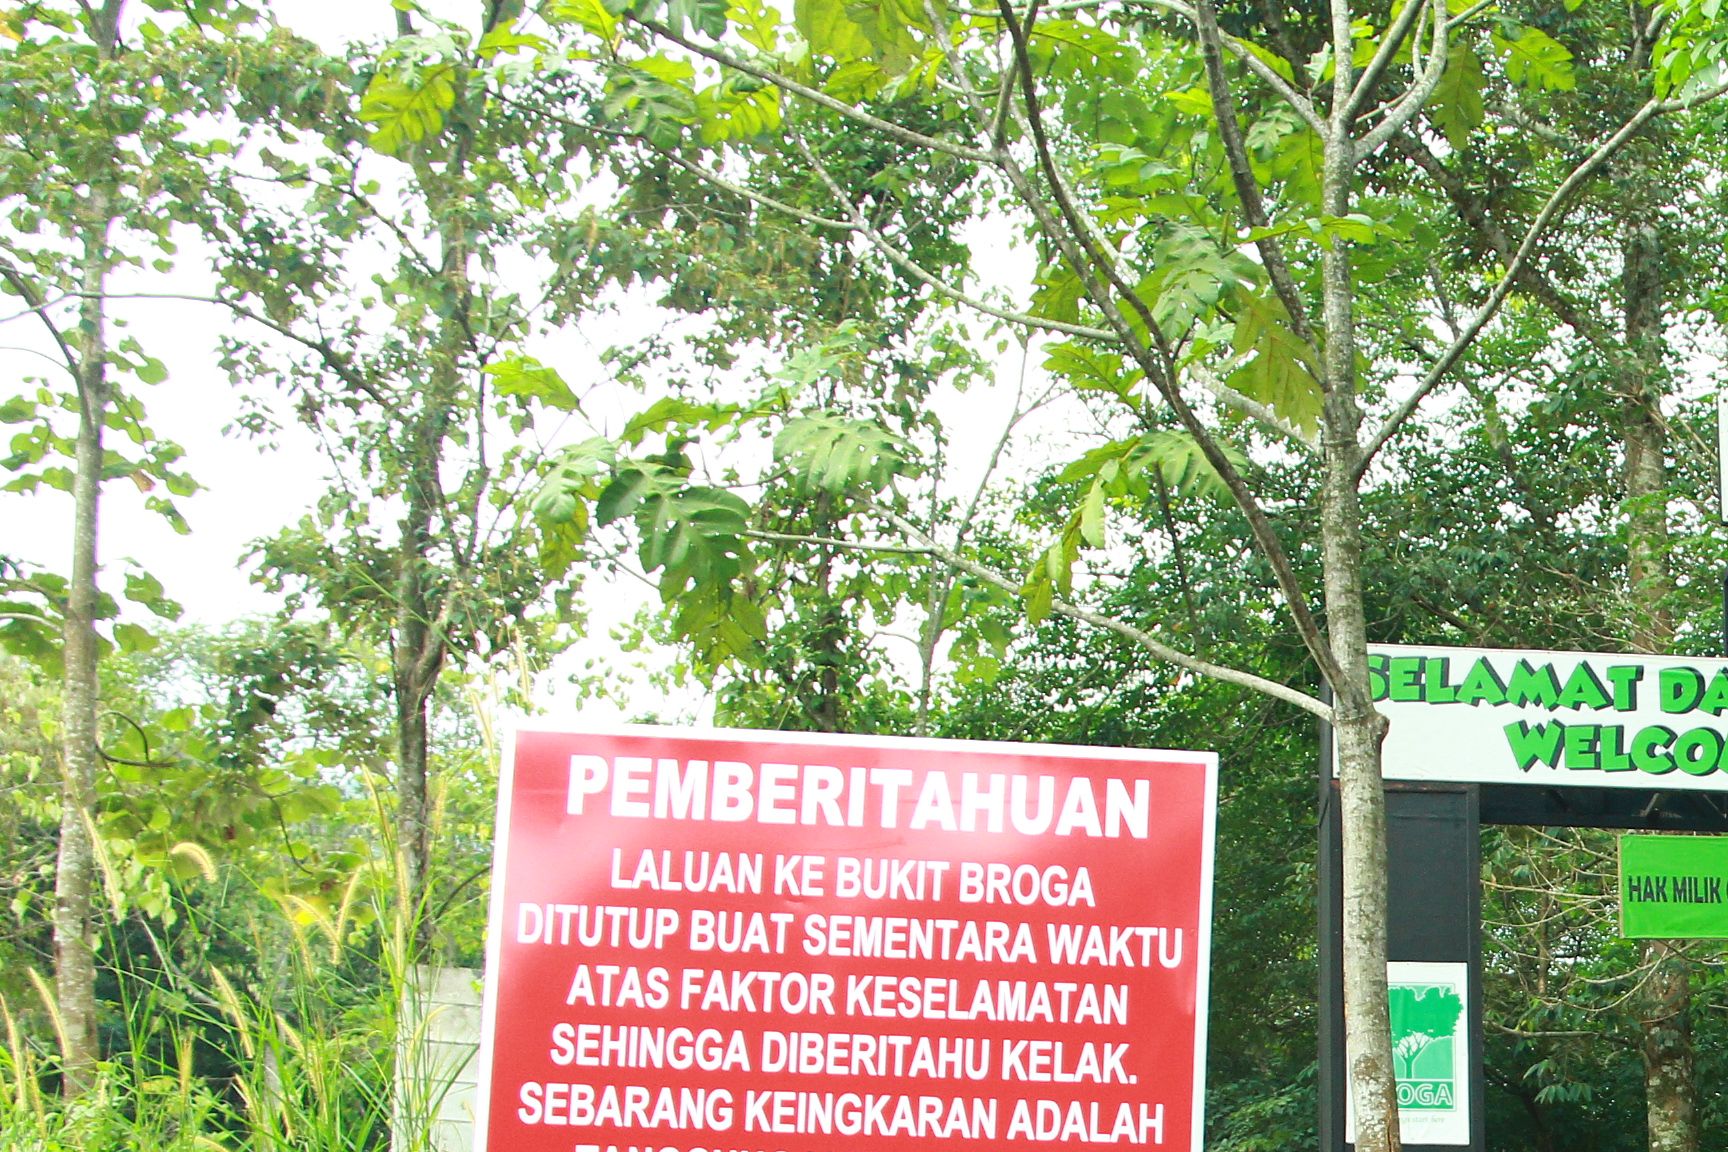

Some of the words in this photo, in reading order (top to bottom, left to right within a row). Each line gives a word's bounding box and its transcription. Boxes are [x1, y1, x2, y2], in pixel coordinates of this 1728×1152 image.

[1367, 653, 1644, 711] SELAMAT
[568, 755, 1149, 838] PEMBERITAHUAN
[612, 848, 762, 893] LALUAN
[775, 855, 825, 896] KE
[837, 857, 949, 900] BUKIT
[960, 862, 1095, 906] BROGA
[1629, 876, 1667, 902] HAK
[1673, 877, 1721, 903] MILIK
[516, 902, 678, 948] DITUTUP
[691, 910, 793, 953] BUAT
[803, 914, 1036, 962] SEMENTARA
[1048, 924, 1182, 967] WAKTU
[567, 965, 668, 1008] ATAS
[682, 969, 834, 1014] FAKTOR
[847, 976, 1127, 1024] KESELAMATAN
[551, 1024, 750, 1071] SEHINGGA
[762, 1032, 989, 1079] DIBERITAHU
[1003, 1040, 1136, 1083] KELAK.
[519, 1082, 732, 1130] SEBARANG
[746, 1091, 996, 1138] KEINGKARAN
[1007, 1100, 1163, 1143] ADALAH
[1396, 1083, 1453, 1105] OGA
